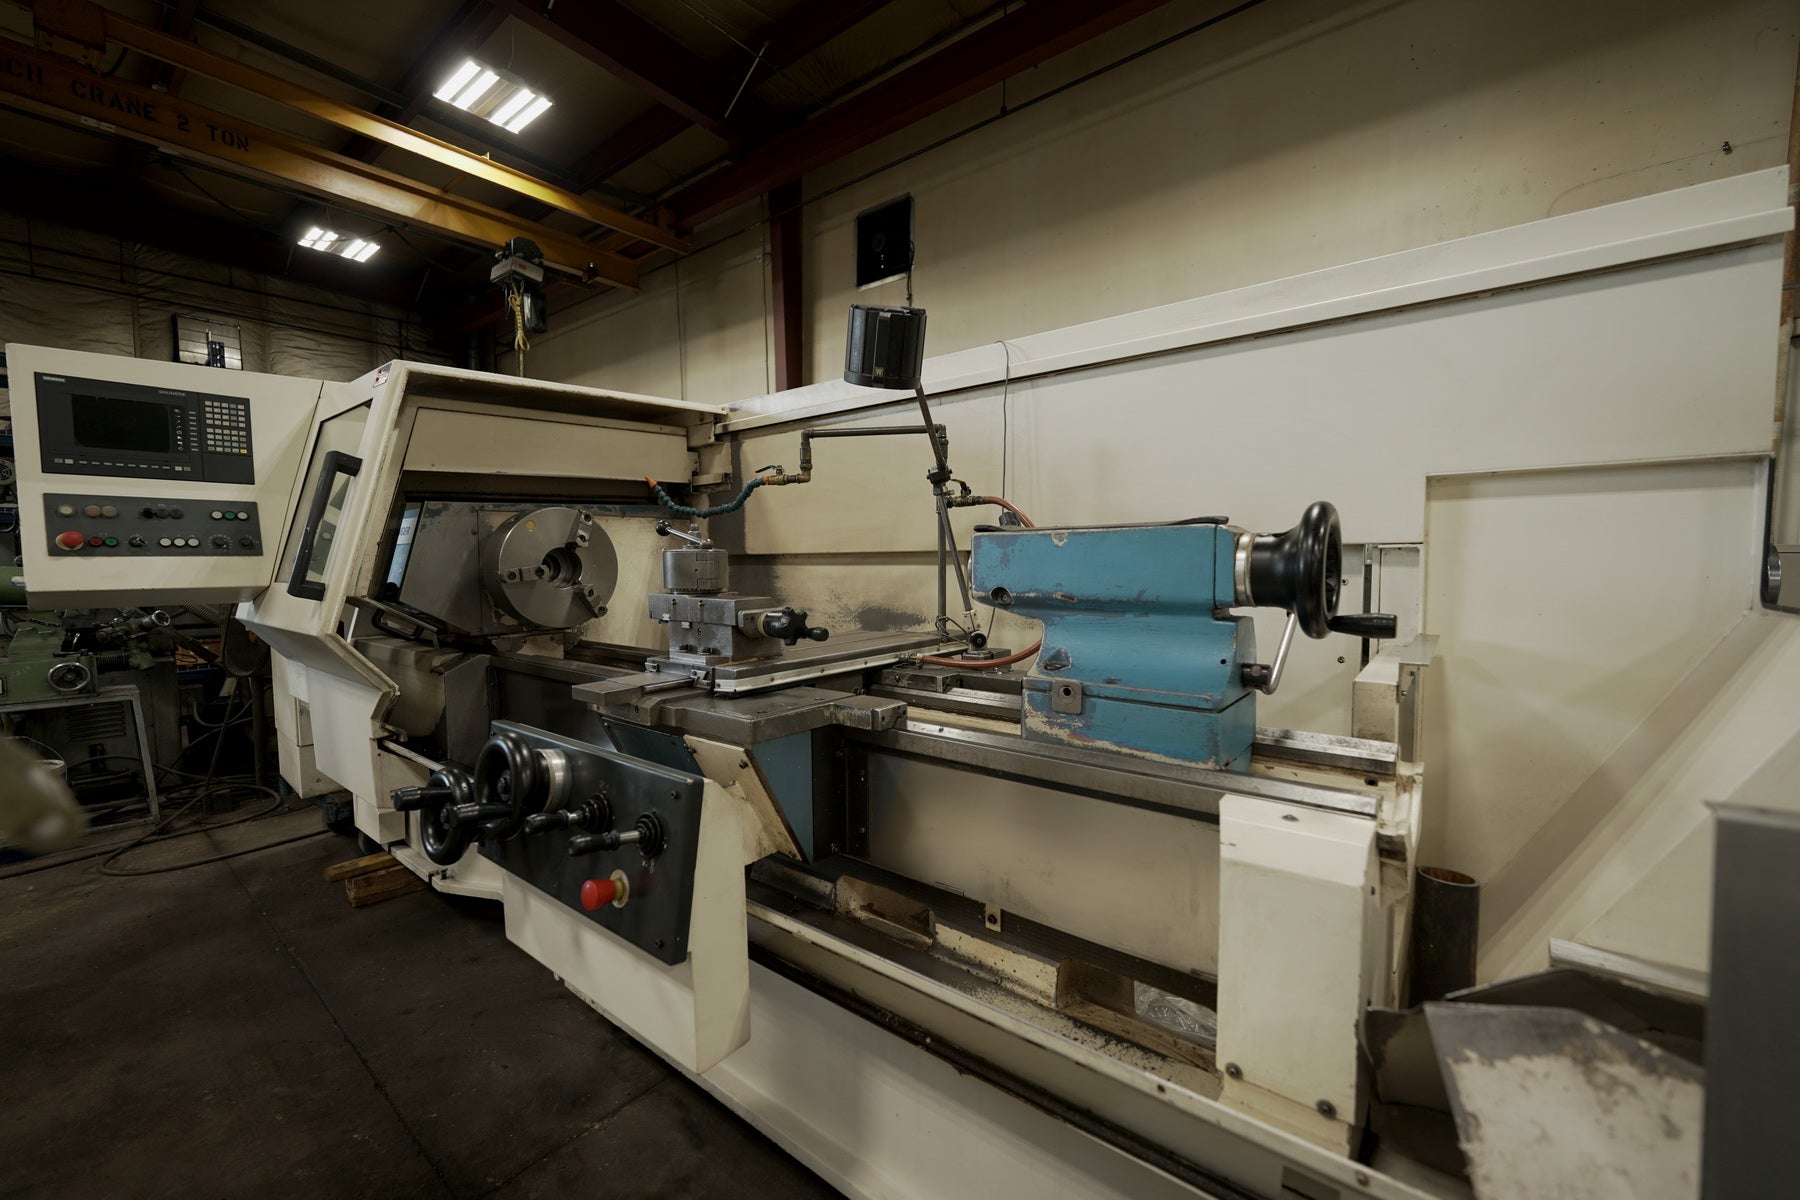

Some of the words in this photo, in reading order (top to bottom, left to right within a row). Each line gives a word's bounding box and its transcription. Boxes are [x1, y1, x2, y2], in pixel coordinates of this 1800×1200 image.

[0, 58, 43, 85] CH
[72, 80, 156, 120] CRANE
[176, 113, 191, 133] 2
[207, 124, 249, 151] TON
